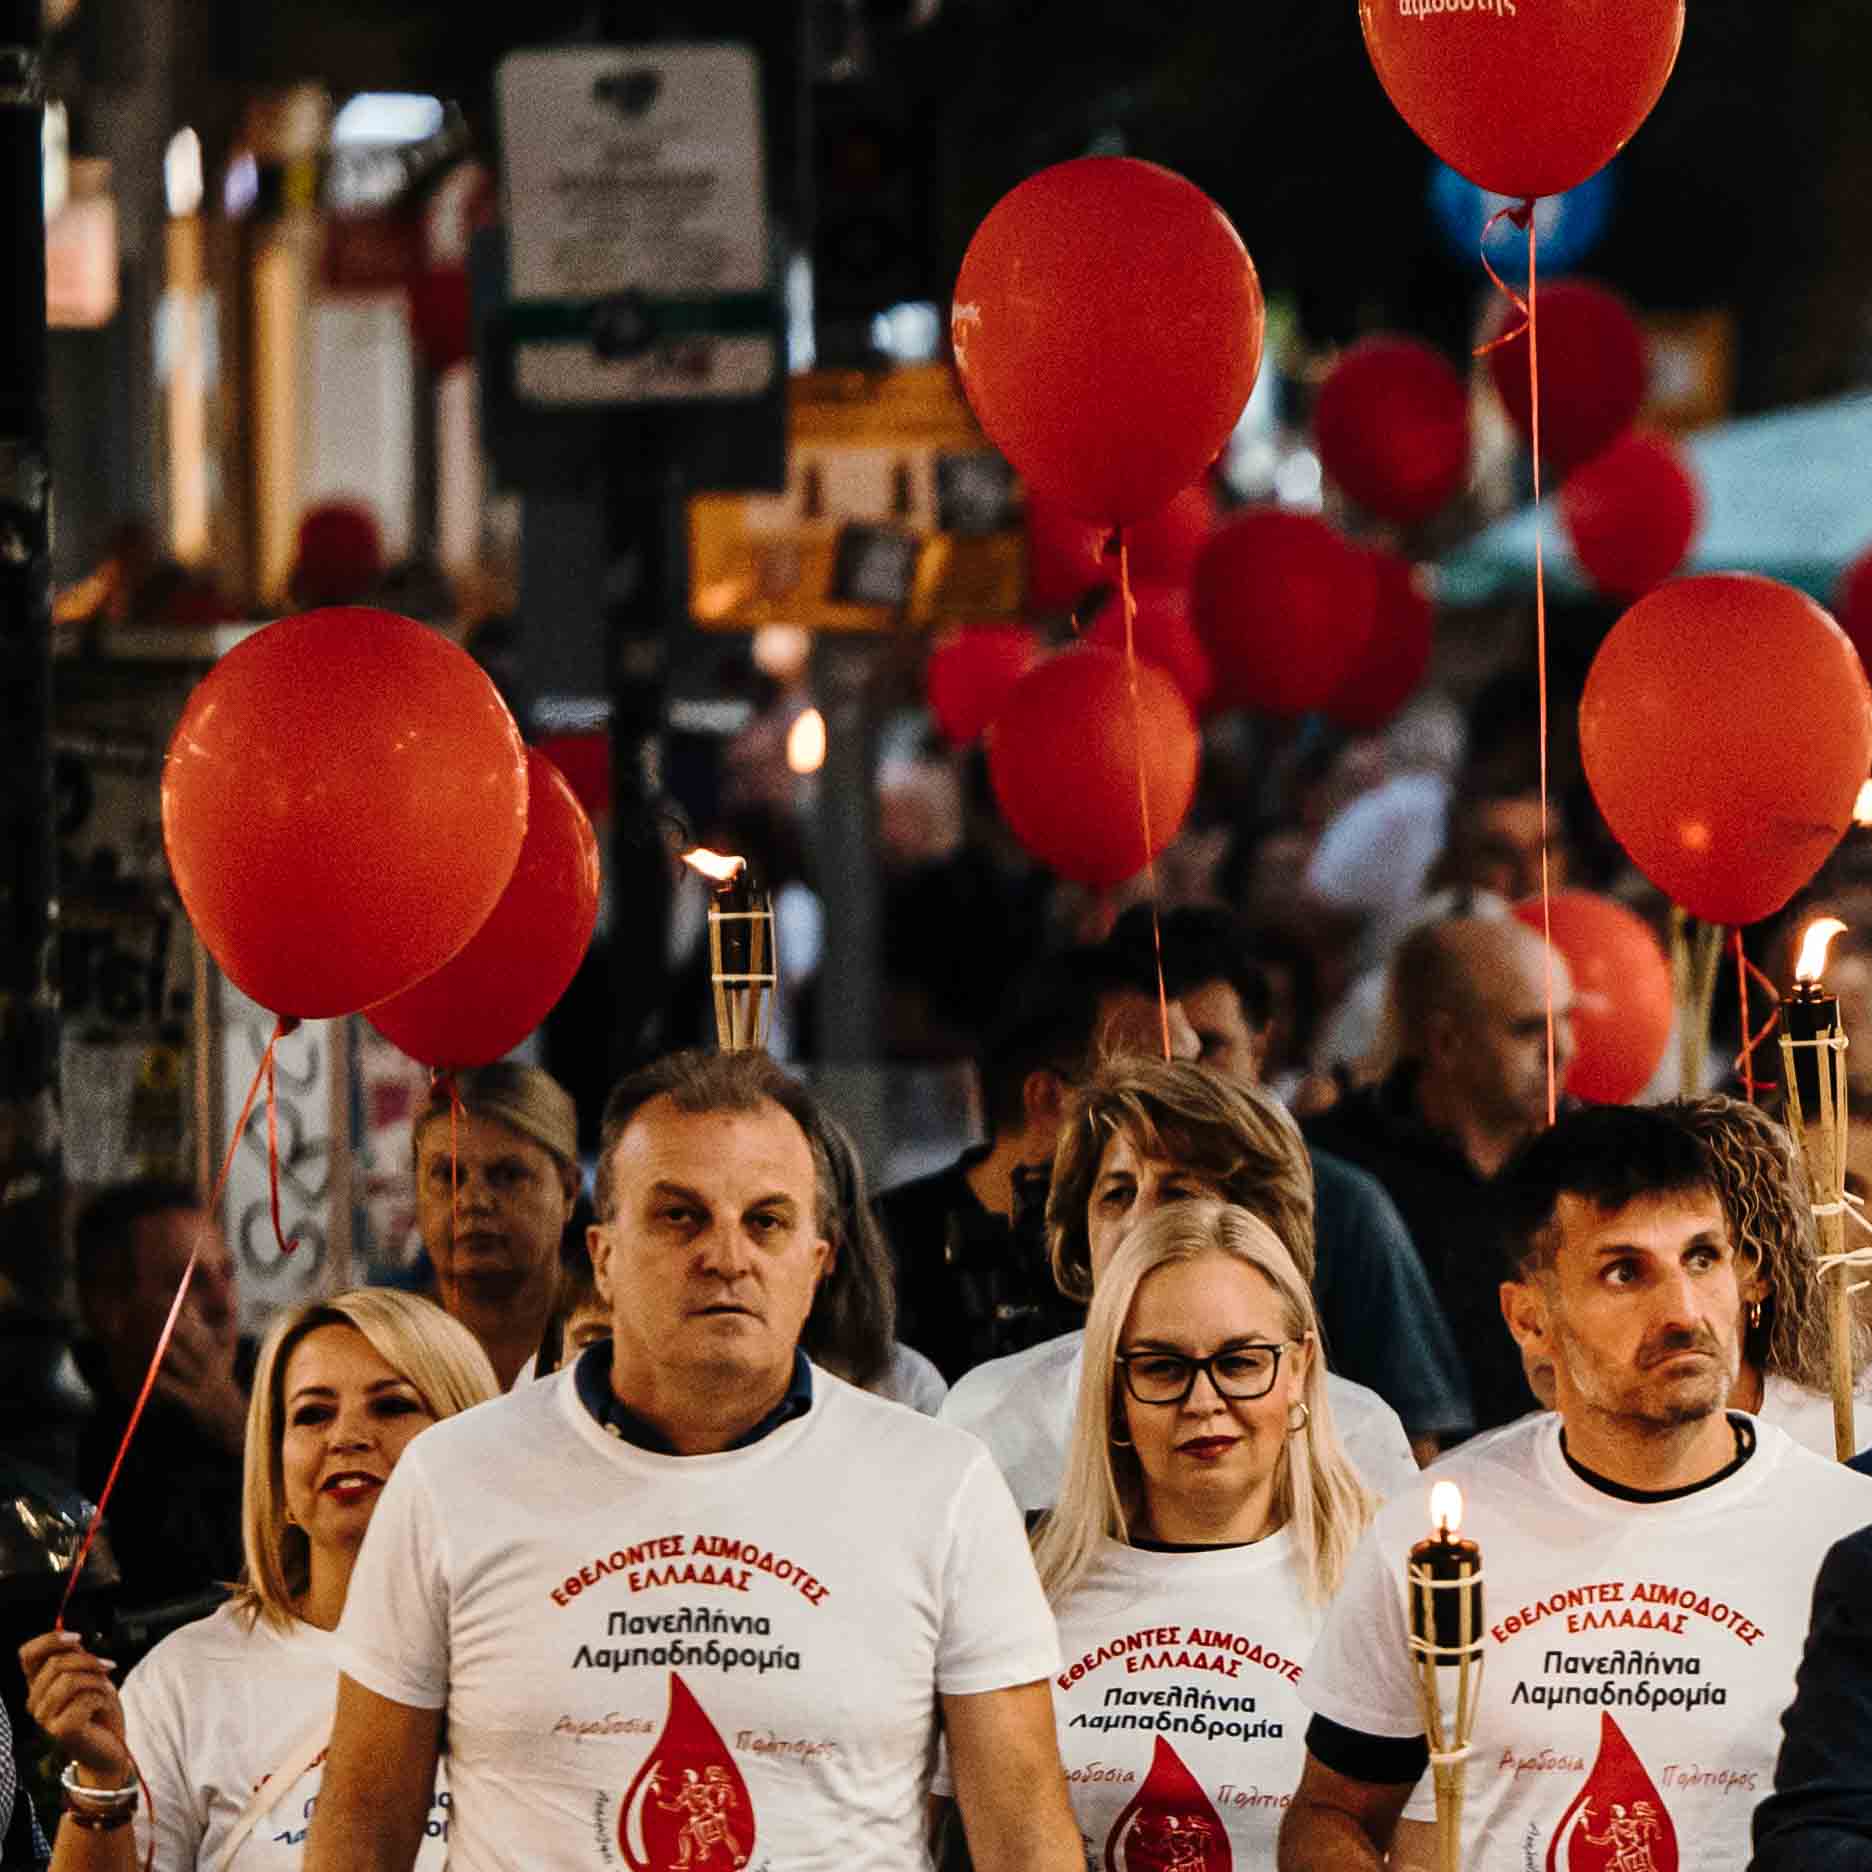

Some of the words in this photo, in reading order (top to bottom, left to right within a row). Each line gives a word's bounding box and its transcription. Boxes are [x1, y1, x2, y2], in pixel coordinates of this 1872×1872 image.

[549, 1534, 685, 1608] ΕΘΕΛΟΝΤΕΣ
[692, 1534, 831, 1607] ΑΙΜΟΔΟΤΕΣ
[628, 1562, 753, 1594] ΕΛΛΑΔΑΣ
[606, 1607, 771, 1638] Πανελλήνια
[1490, 1582, 1625, 1645] ΕΘΕΛΟΝΤΕΣ
[1631, 1583, 1766, 1647] ΑΙΜΟΔΟΤΕΣ
[1567, 1609, 1690, 1635] ΕΛΛΑΔΑΣ
[572, 1639, 801, 1673] Λαμπαδηδρομία
[1056, 1626, 1181, 1691] ΕΘΕΛΟΝΤΕΣ
[1186, 1626, 1304, 1687] ΑΙΜΟΔΟΤΕ
[1125, 1653, 1244, 1679] ΕΛΛΑΔΑΣ
[1543, 1650, 1701, 1676] Πανελλήνια
[1103, 1686, 1256, 1713] Πανελλήνια
[1511, 1680, 1726, 1712] Λαμπαδηδρομία
[1068, 1712, 1284, 1743] Λαμπαδηδρομία
[1217, 1784, 1292, 1810] Πολιτισ
